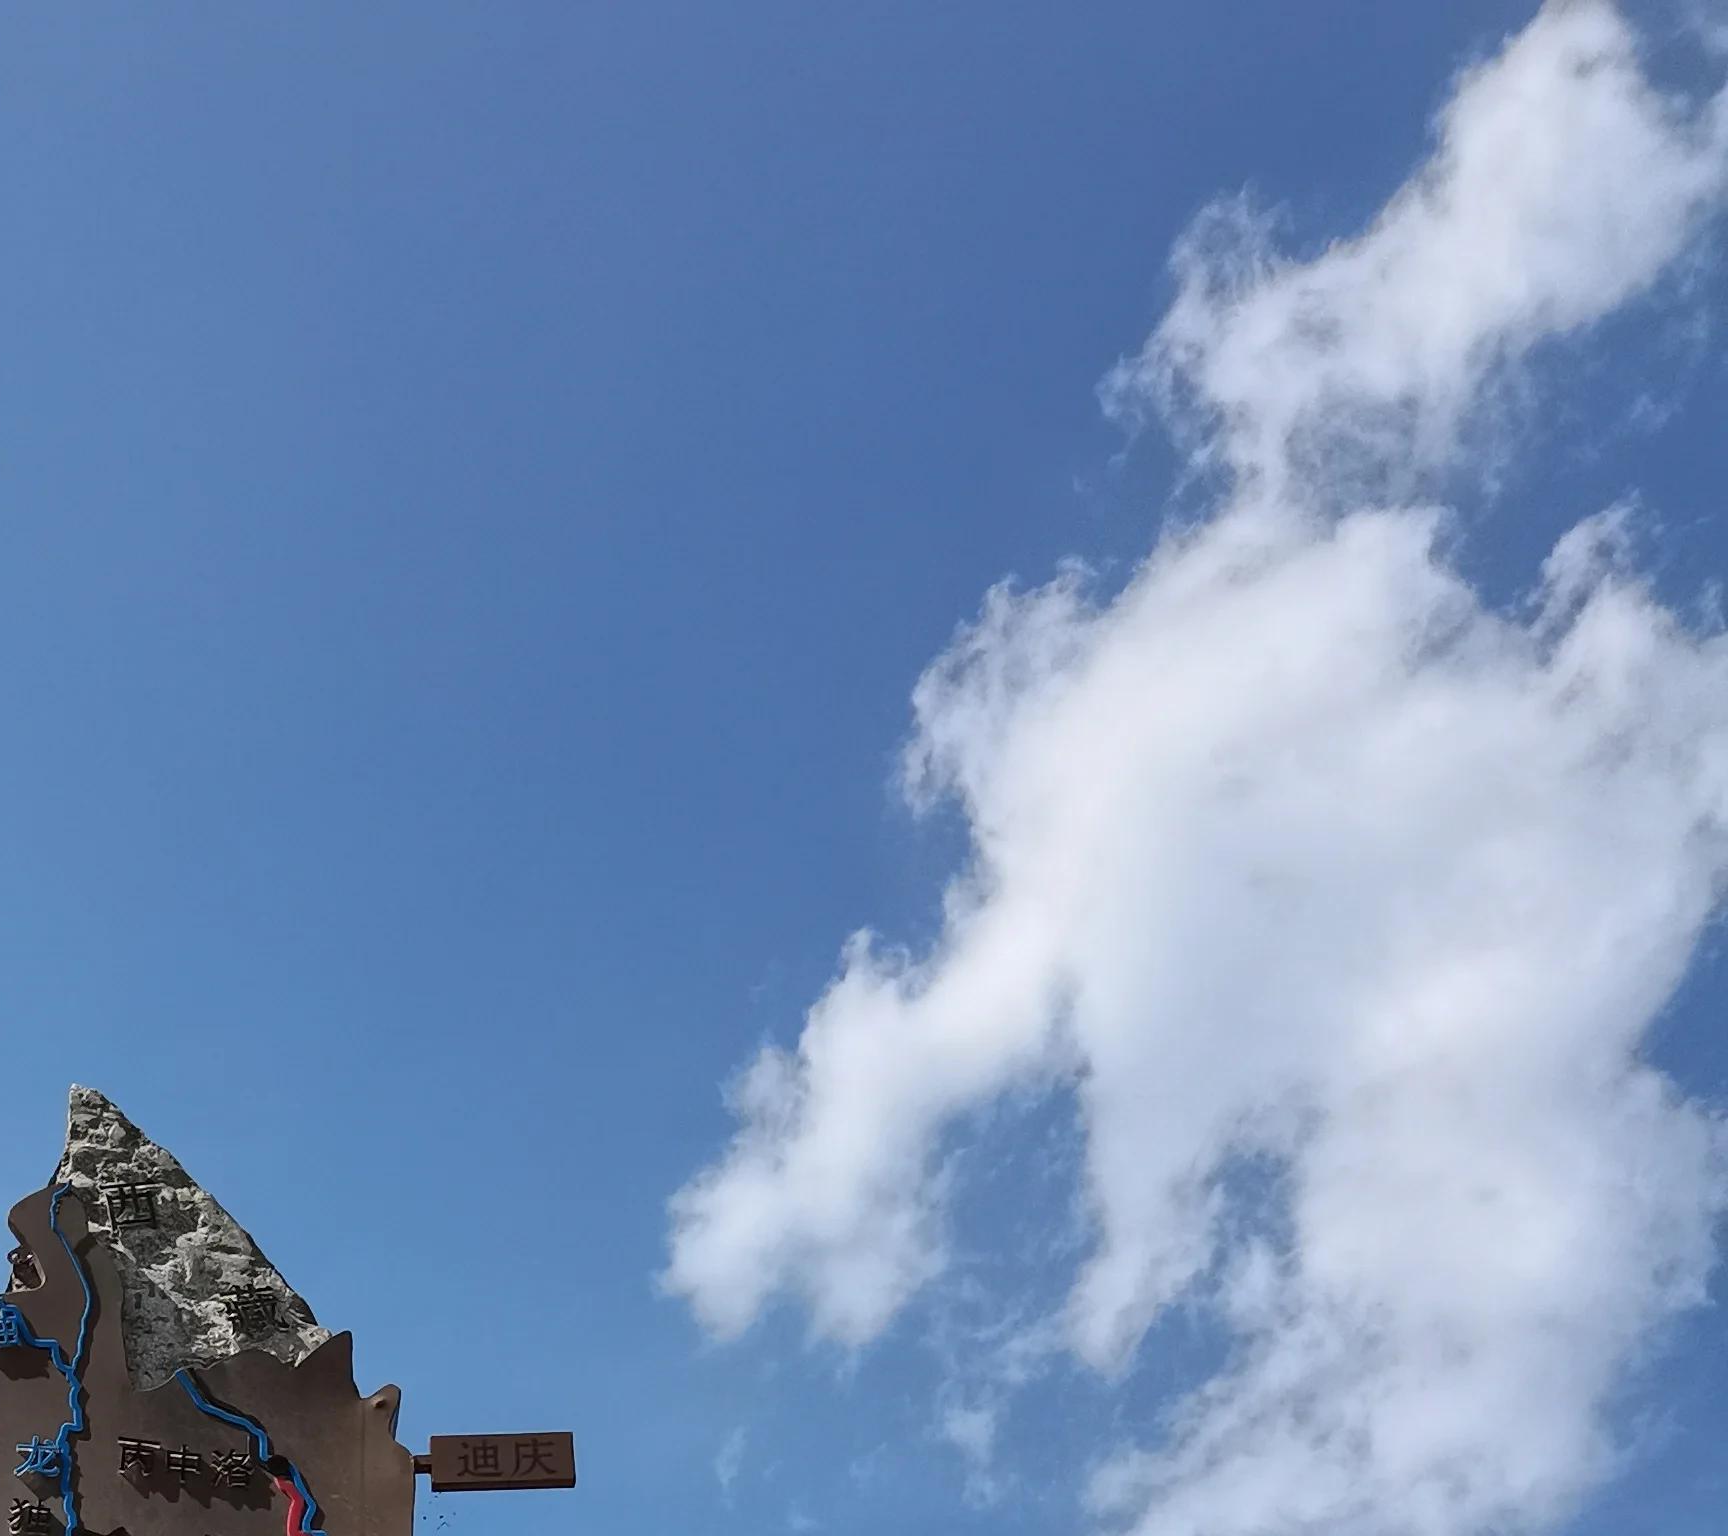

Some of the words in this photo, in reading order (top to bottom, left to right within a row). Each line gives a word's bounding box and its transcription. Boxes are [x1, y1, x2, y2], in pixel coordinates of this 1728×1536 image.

[14, 1435, 62, 1478] 龙
[118, 1436, 256, 1487] 丙中洛
[457, 1438, 558, 1478] 迪庆
